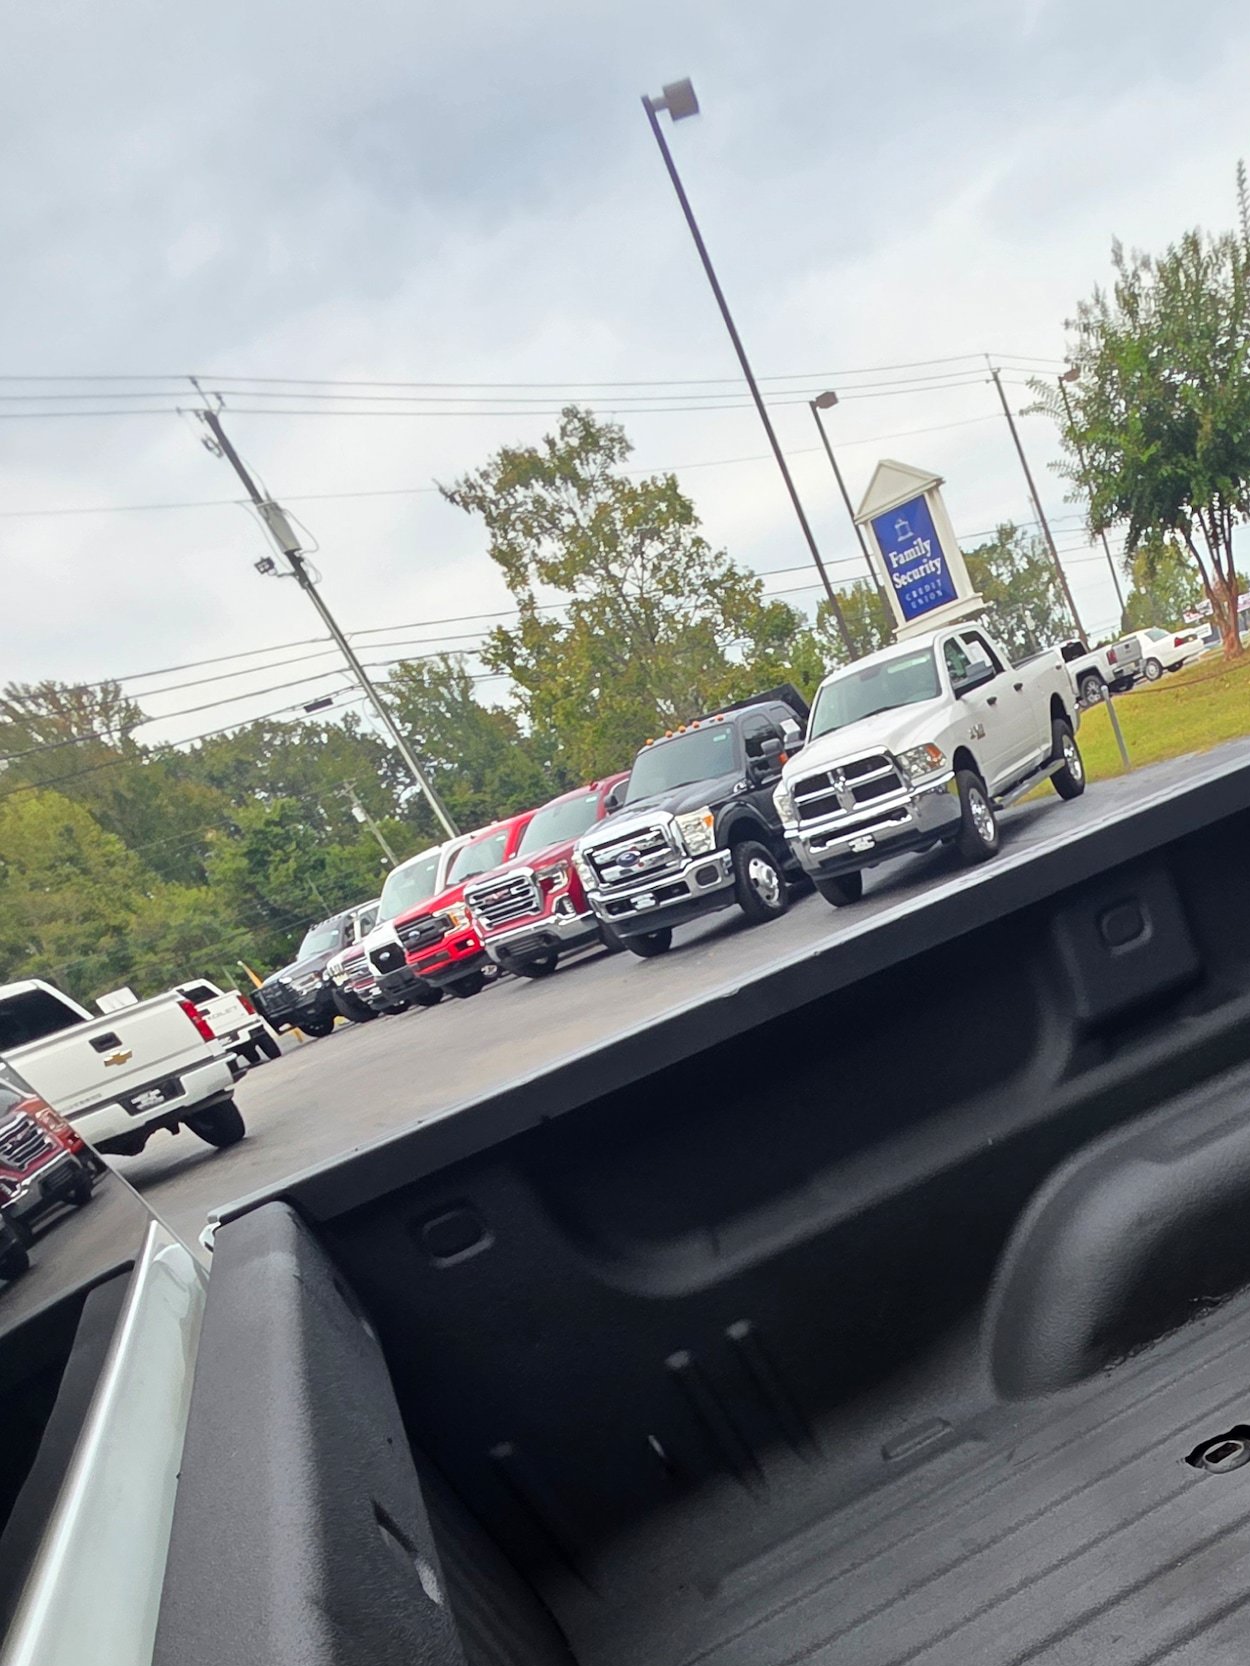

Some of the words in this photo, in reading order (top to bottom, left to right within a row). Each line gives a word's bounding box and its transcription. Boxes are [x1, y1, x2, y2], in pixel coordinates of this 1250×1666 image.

[888, 537, 931, 568] Family
[892, 557, 941, 589] Security
[905, 579, 942, 601] CREDIT
[911, 590, 943, 609] UNION
